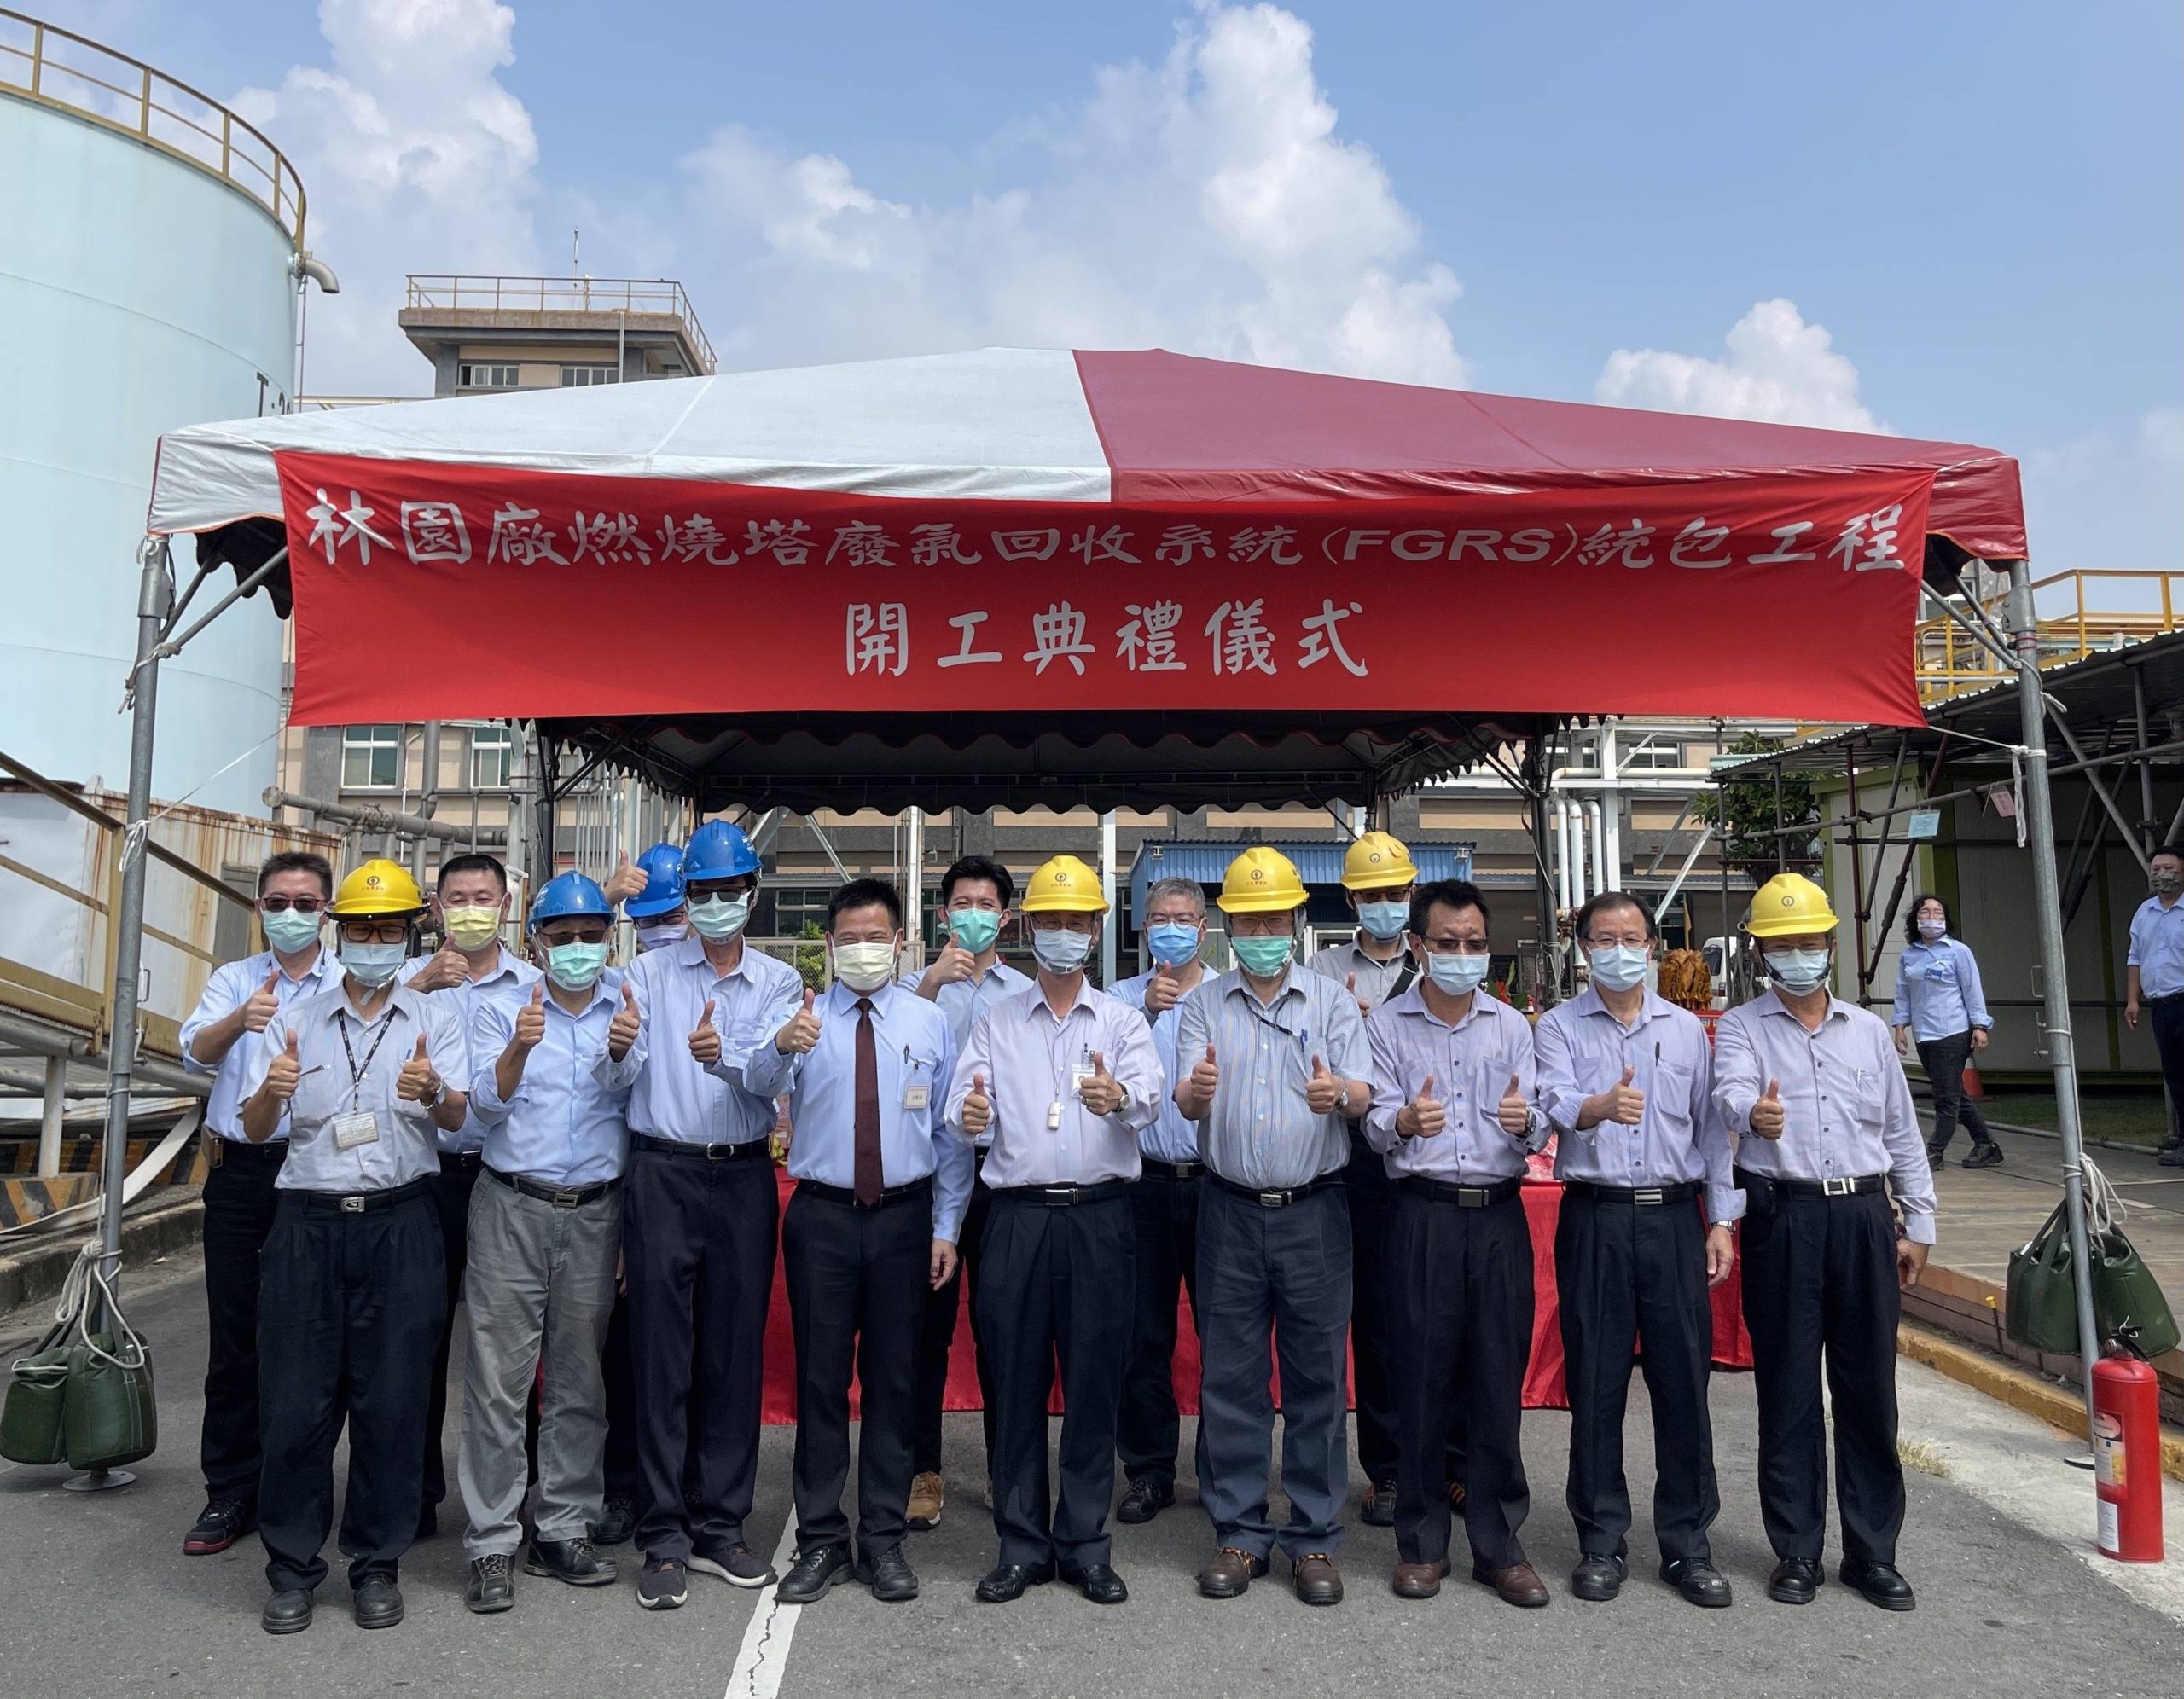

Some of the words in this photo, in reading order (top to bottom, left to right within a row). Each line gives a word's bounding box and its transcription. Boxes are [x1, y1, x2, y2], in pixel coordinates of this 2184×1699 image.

[845, 599, 1369, 677] 開工典禮儀式
